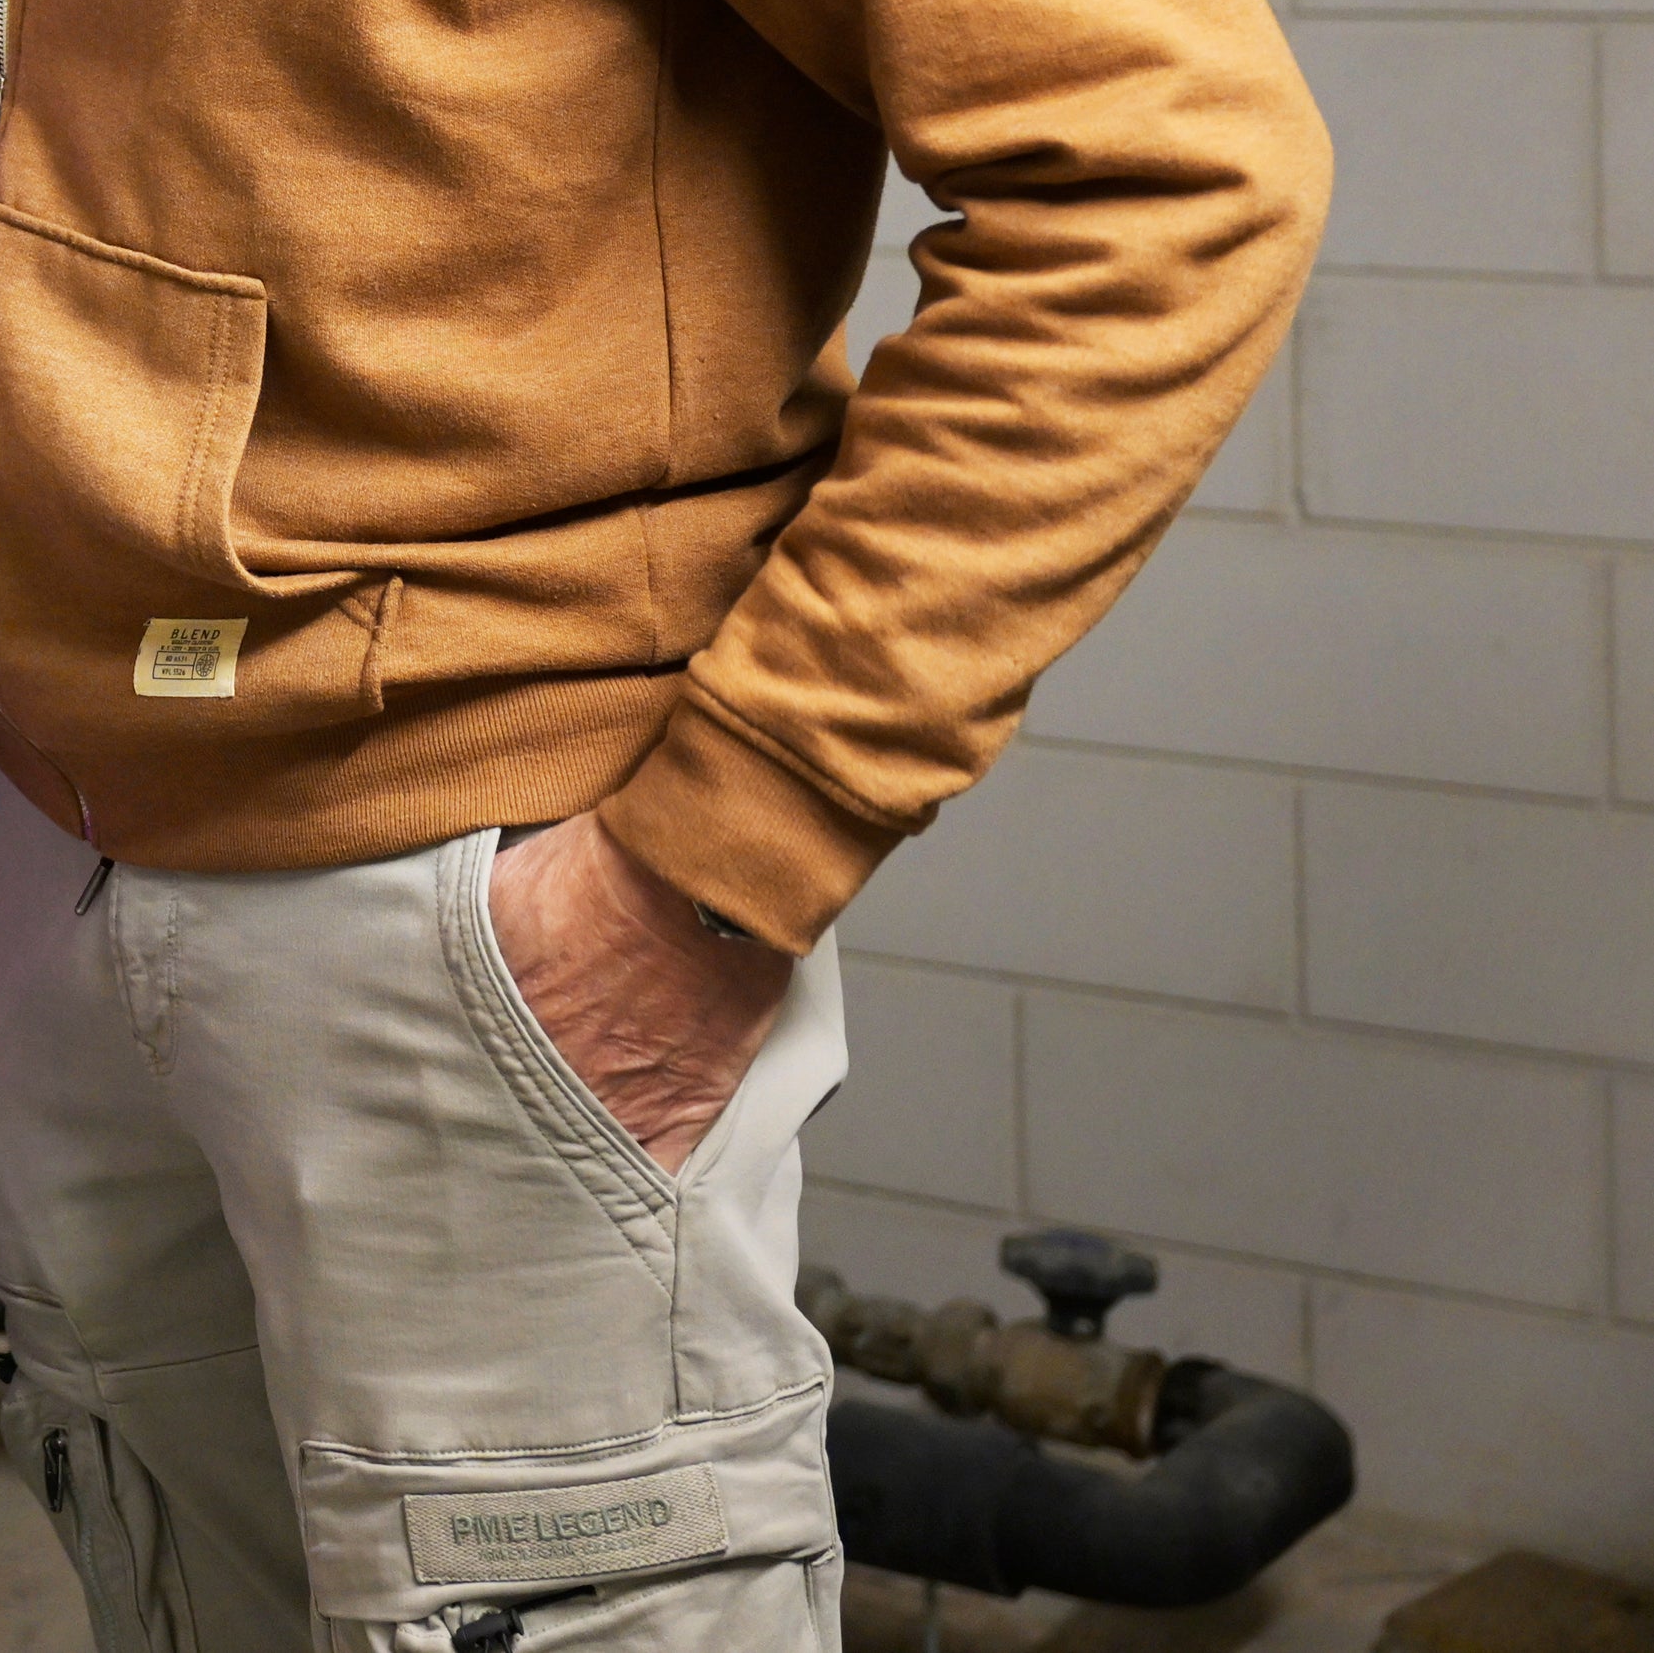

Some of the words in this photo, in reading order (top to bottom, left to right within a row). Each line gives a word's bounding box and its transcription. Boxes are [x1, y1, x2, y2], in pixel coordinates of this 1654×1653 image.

[171, 628, 221, 640] BLEND
[453, 1513, 528, 1545] PME
[535, 1498, 673, 1541] LEGEND
